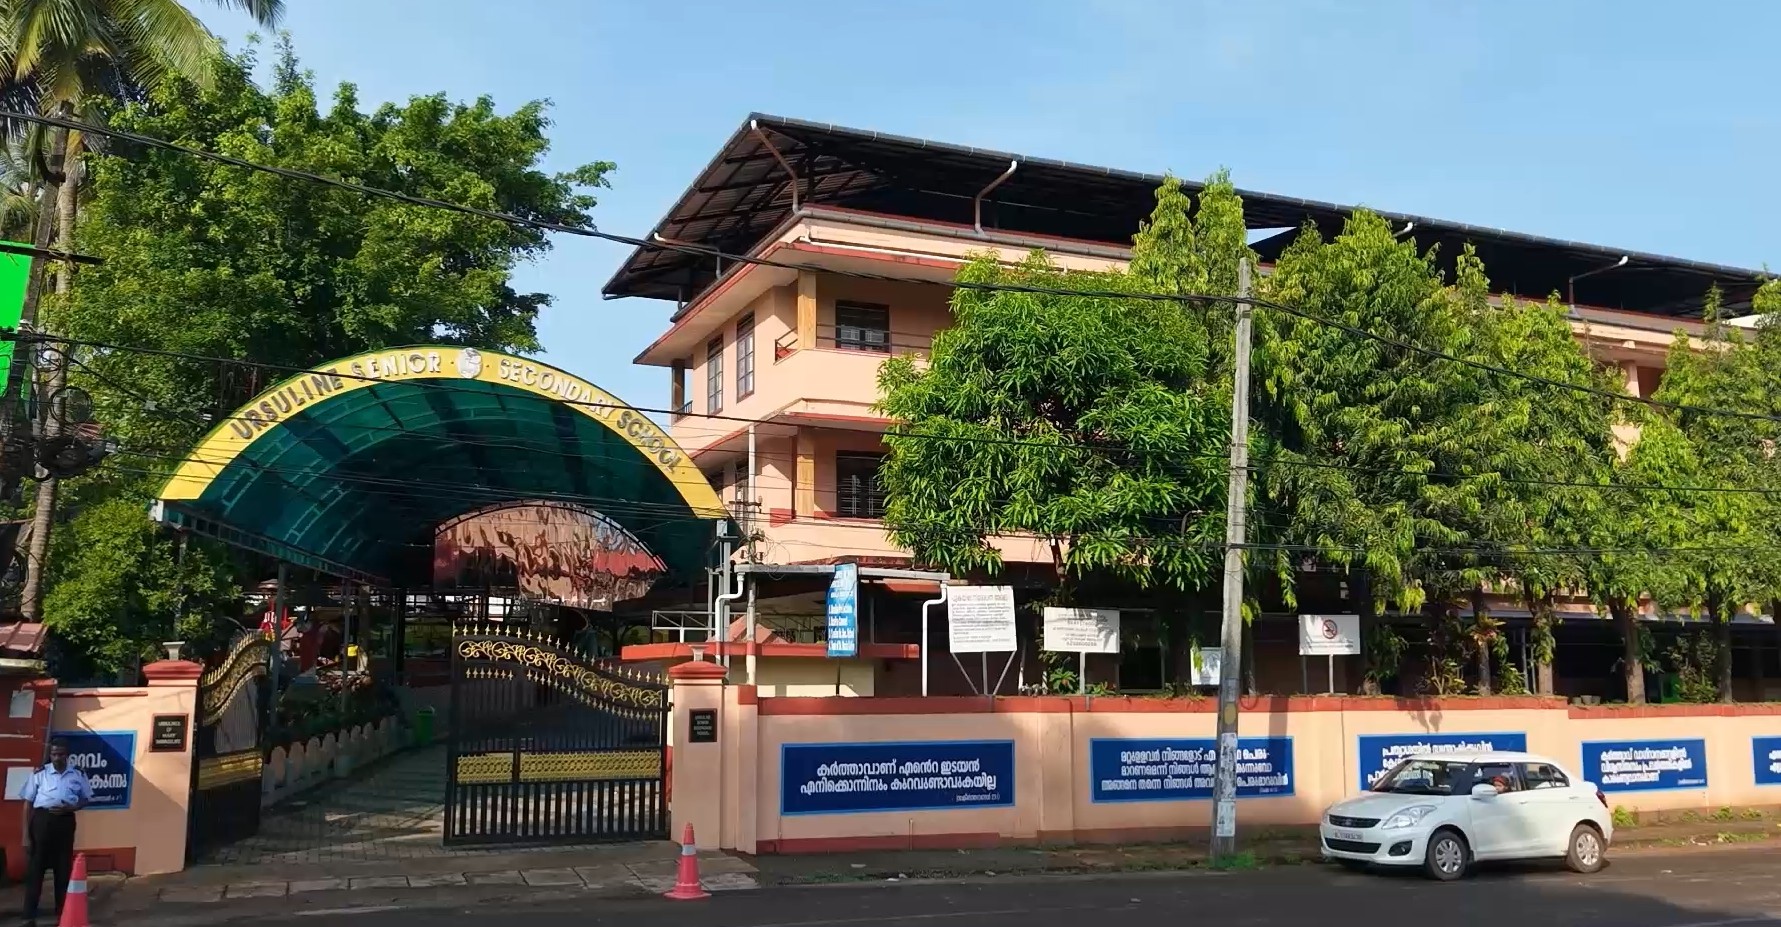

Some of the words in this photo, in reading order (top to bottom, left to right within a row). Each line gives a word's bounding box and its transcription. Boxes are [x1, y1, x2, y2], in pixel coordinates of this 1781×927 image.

[230, 367, 344, 441] URSULINE
[351, 353, 442, 382] SENIOR
[500, 358, 618, 420] SECONDARY
[617, 410, 682, 474] SCHOOL
[817, 758, 897, 777] കർത്താവാണ്
[940, 758, 980, 775] ഇടയൻ
[800, 776, 888, 795] എനിക്കൊന്നിനും
[890, 772, 998, 791] കുറവുണ്ടാവുകയില്ല
